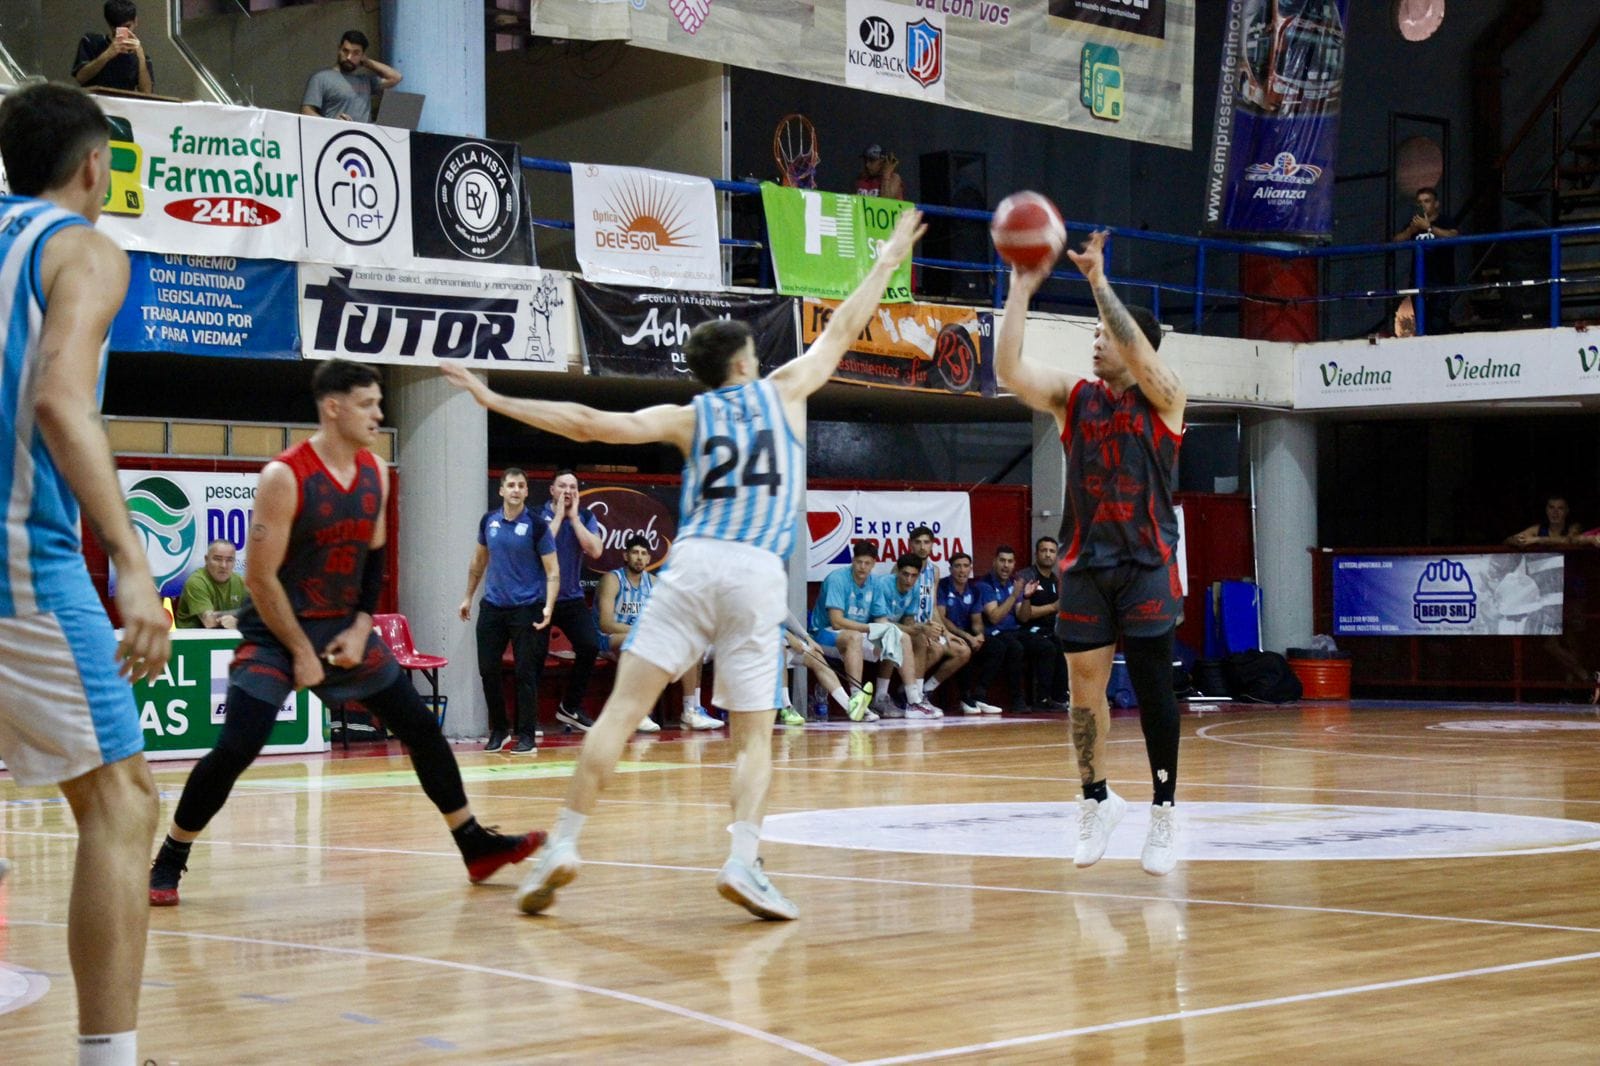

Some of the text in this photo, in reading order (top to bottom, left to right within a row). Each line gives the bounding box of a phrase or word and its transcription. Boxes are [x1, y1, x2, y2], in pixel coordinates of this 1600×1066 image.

[942, 0, 974, 17] con
[979, 2, 1010, 25] vos
[849, 49, 905, 73] KICKBACK
[169, 126, 281, 159] farmacia
[148, 156, 298, 198] FarmaSur
[445, 150, 478, 183] BELLA
[480, 151, 508, 189] VISTA
[332, 180, 378, 209] rio
[1252, 186, 1307, 199] Alianza
[347, 209, 384, 230] net
[863, 198, 903, 230] hor
[187, 254, 237, 271] GREMIO
[150, 268, 246, 290] CON IDENTIDAD
[158, 288, 243, 309] LEGISLATIVA...
[648, 294, 677, 304] COCINA
[141, 306, 253, 328] TRABAJANDO POR
[304, 267, 519, 361] TUTOR
[145, 325, 158, 339] Y
[161, 325, 189, 343] PARA
[838, 358, 900, 379] estimientos
[1320, 361, 1392, 387] Viedma
[1445, 354, 1521, 382] Viedma
[702, 429, 782, 500] 24
[207, 508, 254, 551] DO
[1421, 605, 1468, 617] BERO SRL
